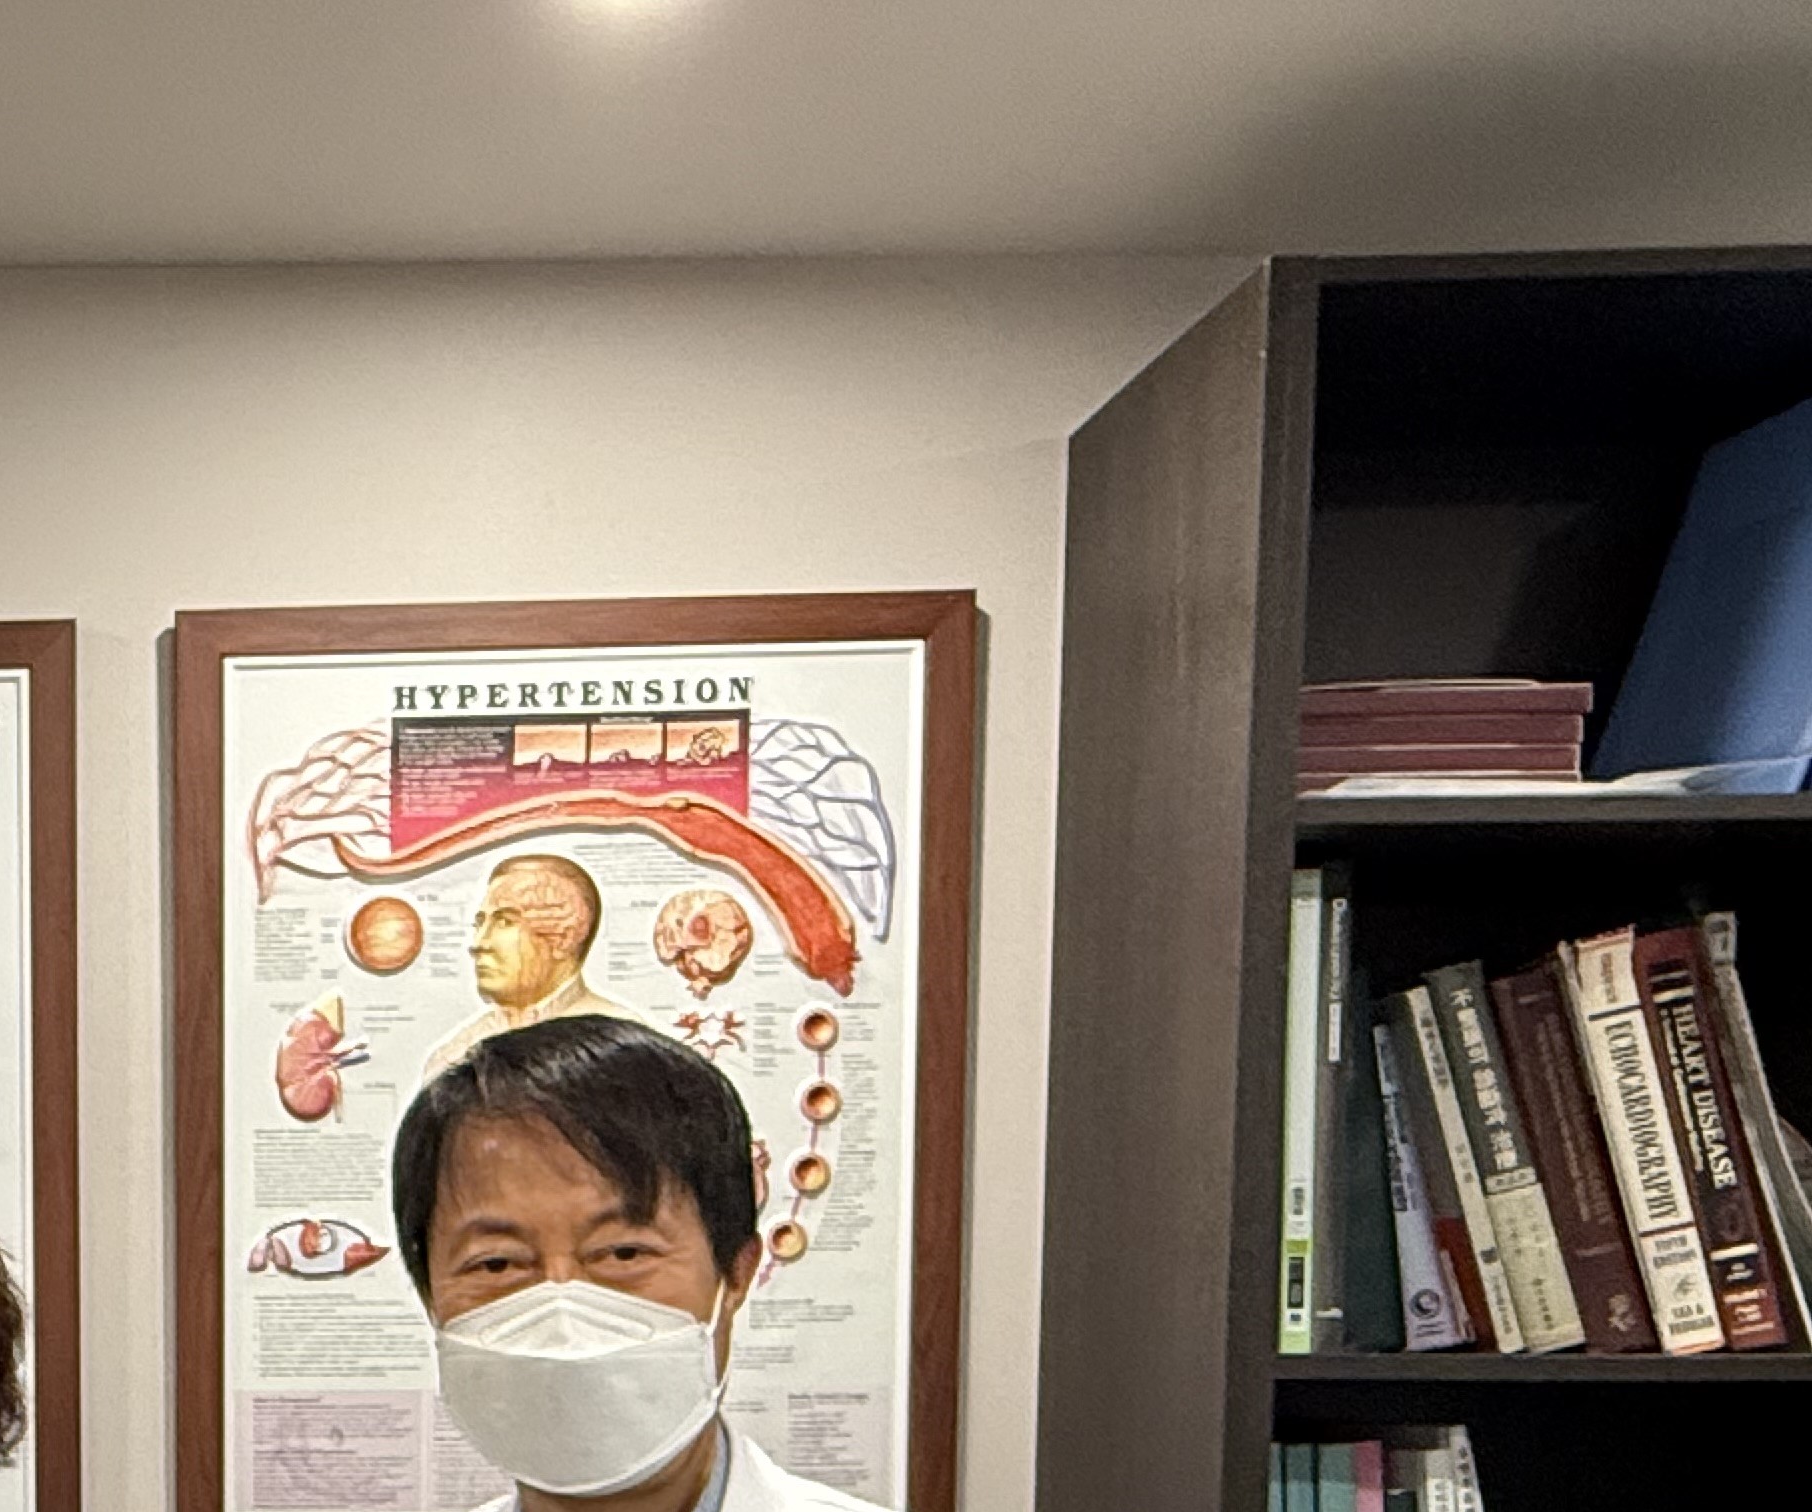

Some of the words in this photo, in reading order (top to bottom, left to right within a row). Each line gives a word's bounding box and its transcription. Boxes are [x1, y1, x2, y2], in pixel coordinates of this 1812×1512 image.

[393, 676, 754, 711] HYPERTENSION
[1672, 1004, 1713, 1085] HEART
[1604, 1020, 1680, 1220] ECHOCARDIOGRAPHY
[1692, 1089, 1738, 1190] DISEASE
